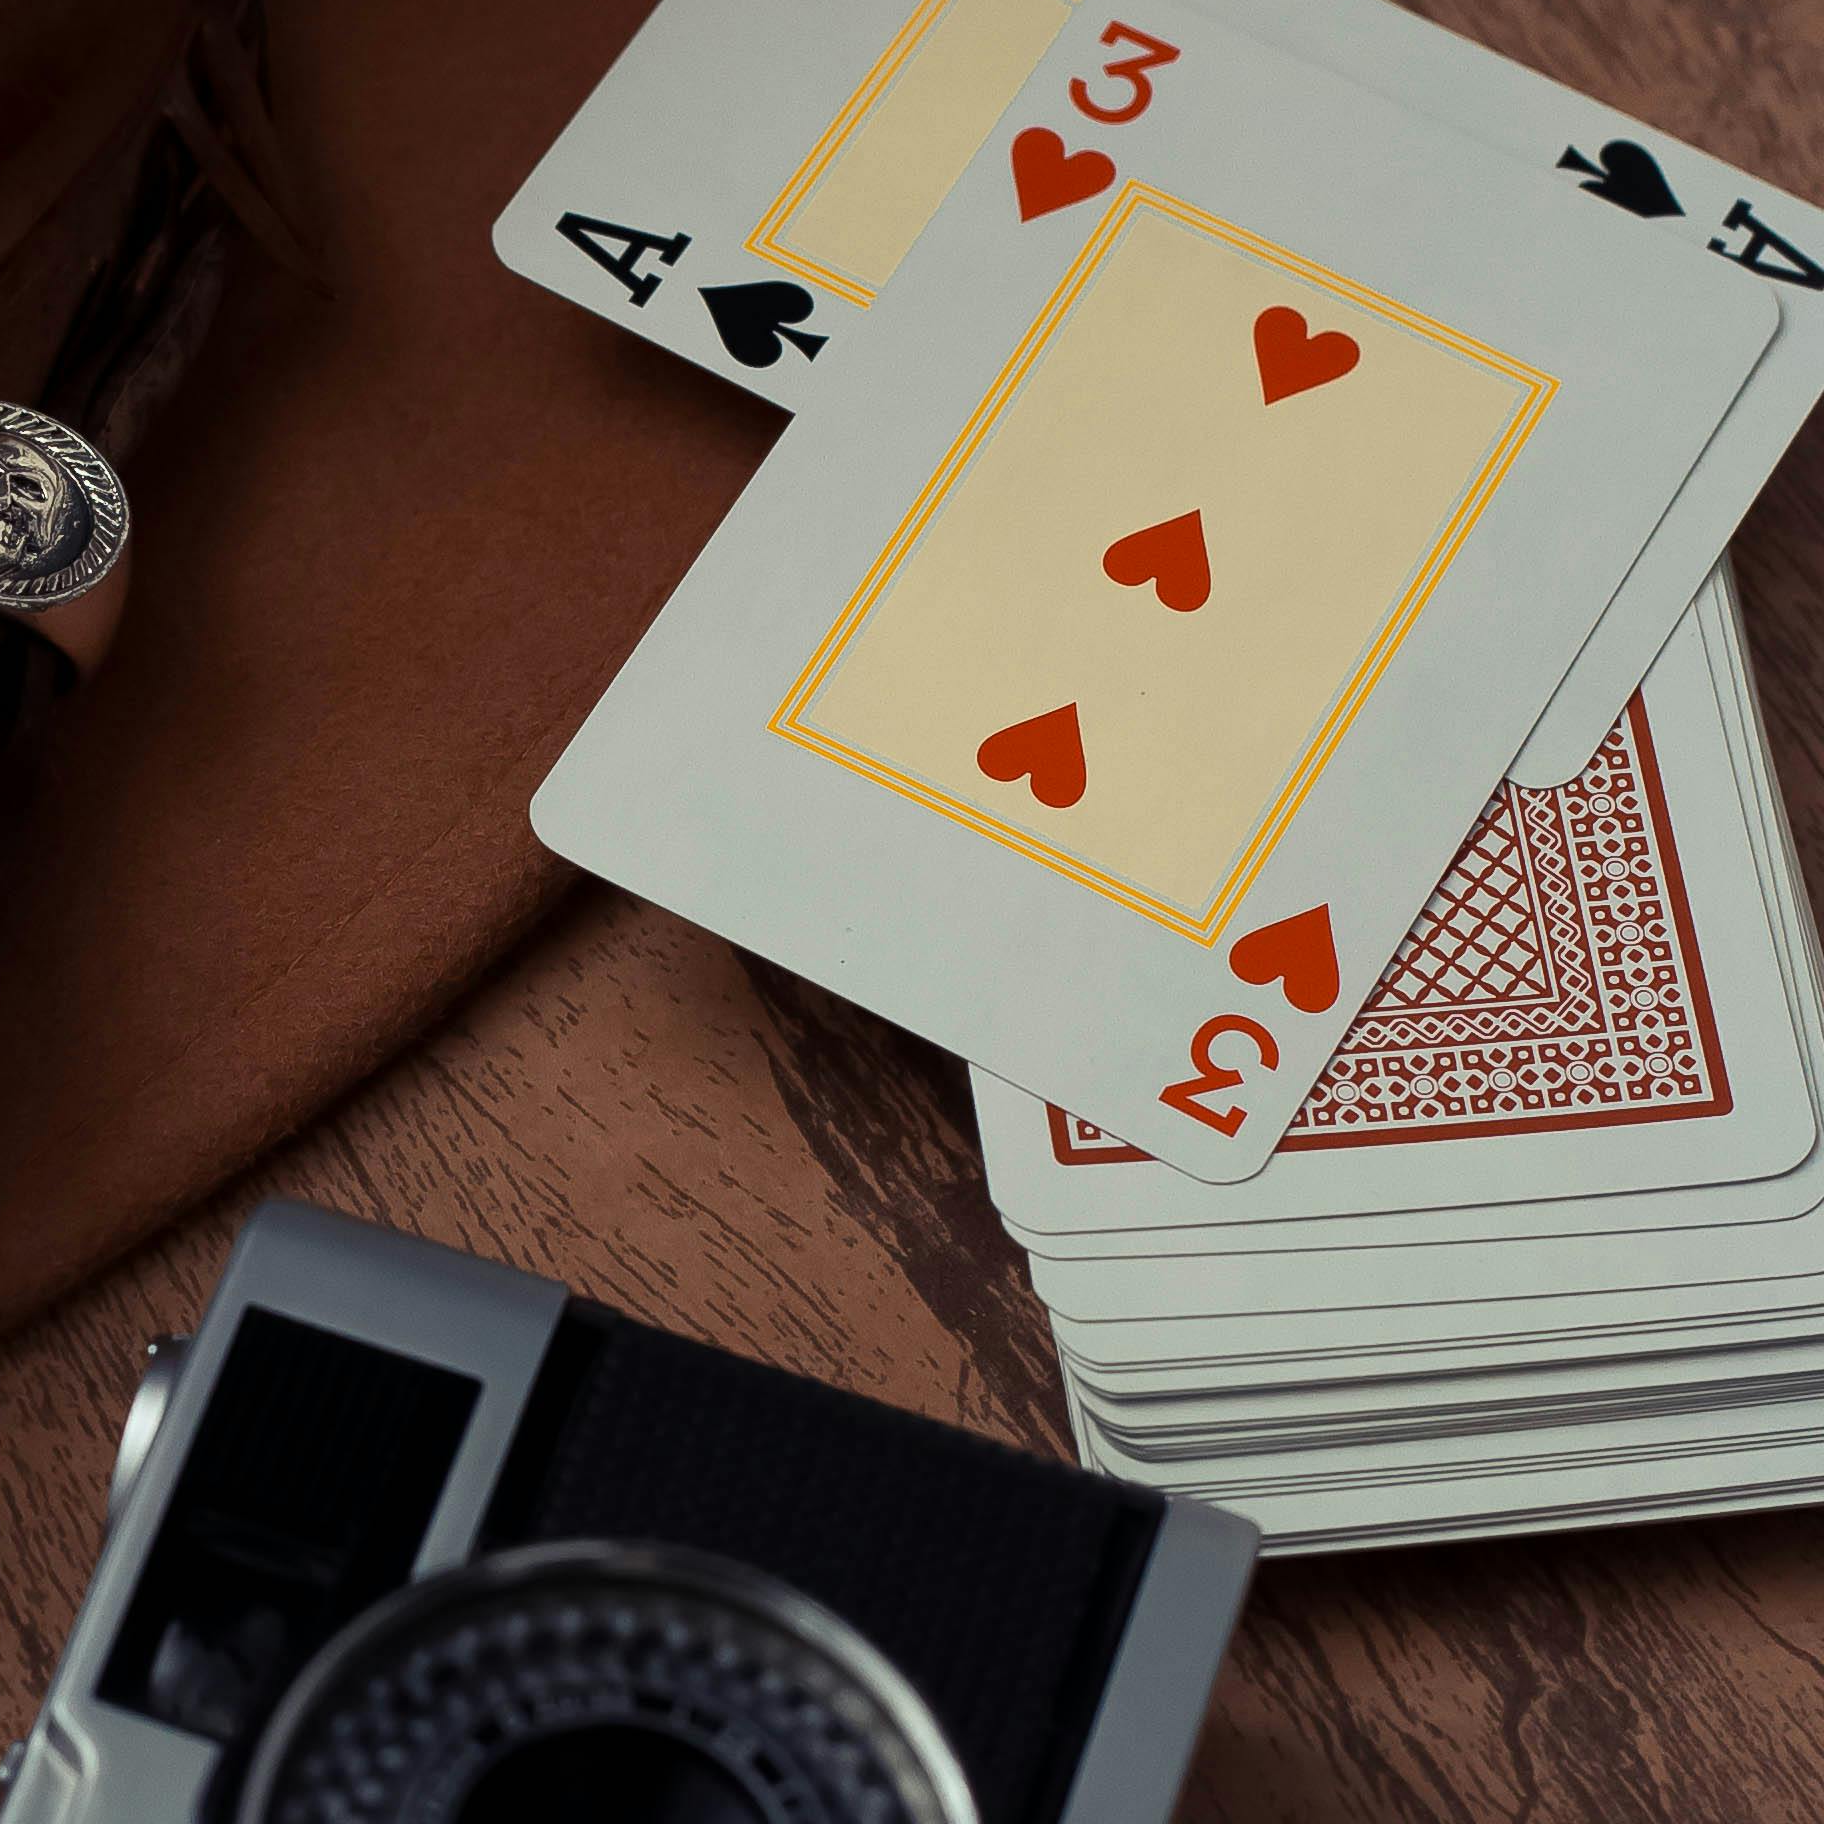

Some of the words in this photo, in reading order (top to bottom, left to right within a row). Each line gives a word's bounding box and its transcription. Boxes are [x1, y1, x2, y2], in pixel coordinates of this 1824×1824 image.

[1068, 19, 1181, 125] 3
[555, 211, 692, 308] A
[1706, 198, 1824, 291] A
[1157, 1013, 1280, 1138] 3
